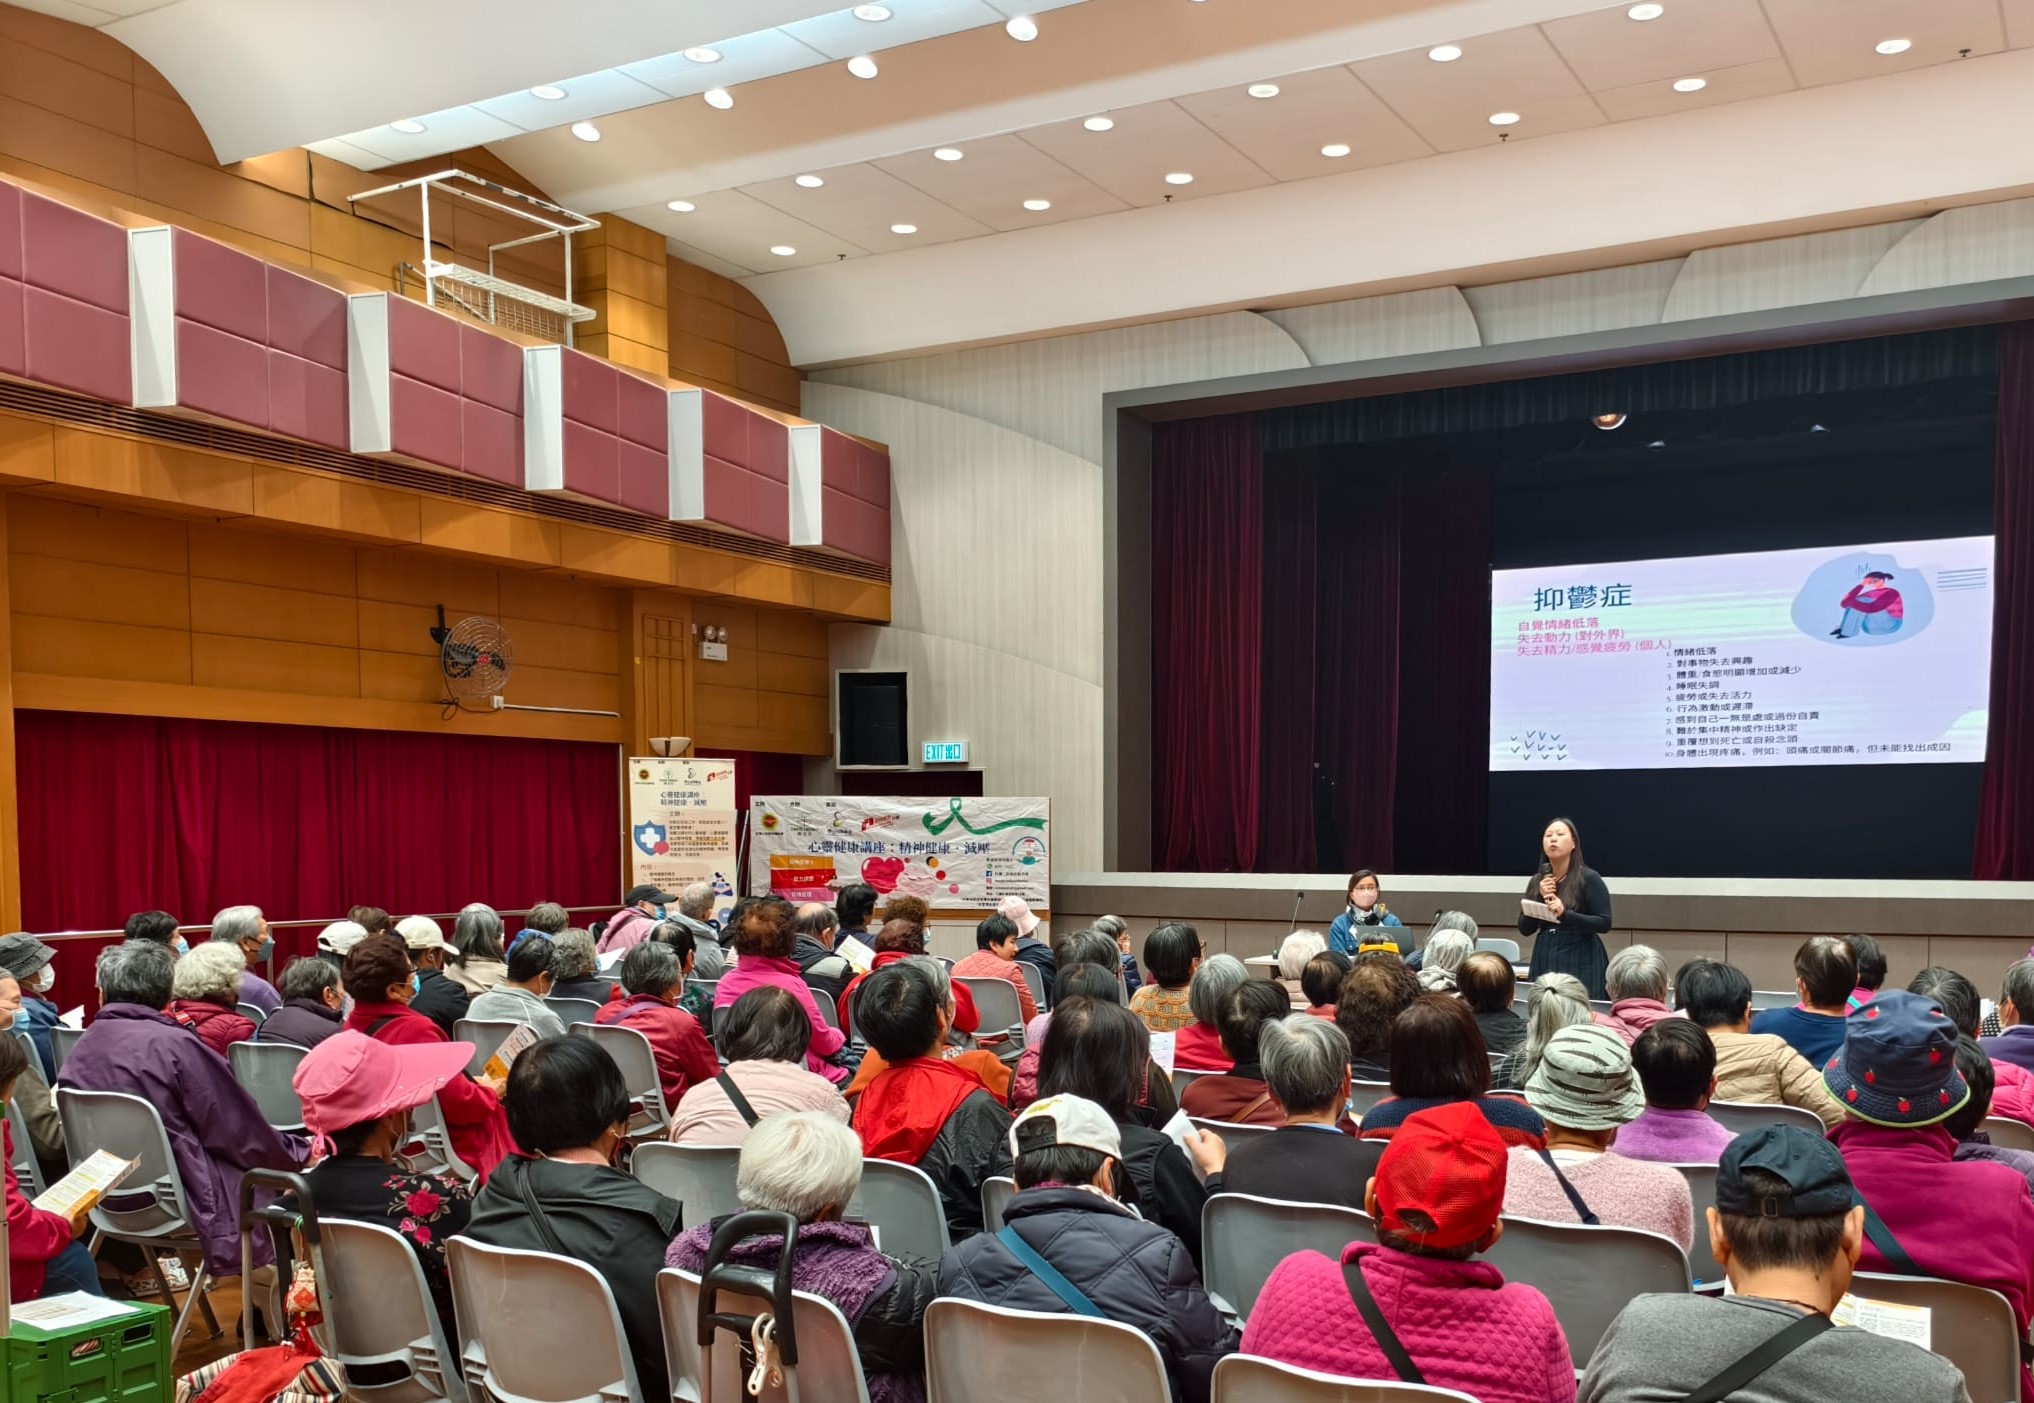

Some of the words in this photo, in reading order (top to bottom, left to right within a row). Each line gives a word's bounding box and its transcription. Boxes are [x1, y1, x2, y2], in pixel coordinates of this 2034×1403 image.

[1534, 583, 1632, 612] 抑鬱症
[1518, 617, 1599, 631] 自覺情緒低落
[1517, 631, 1571, 645] 失去動力
[1517, 641, 1631, 656] 失去精力/感覺疲勞
[1674, 647, 1717, 657] 情緒低落
[1676, 656, 1753, 667] 對事物失去興趣
[1676, 681, 1720, 690] 睡眠失調
[1675, 691, 1752, 701] 疲勞或失去活力
[926, 744, 944, 760] EXIT
[946, 744, 961, 760] 出口
